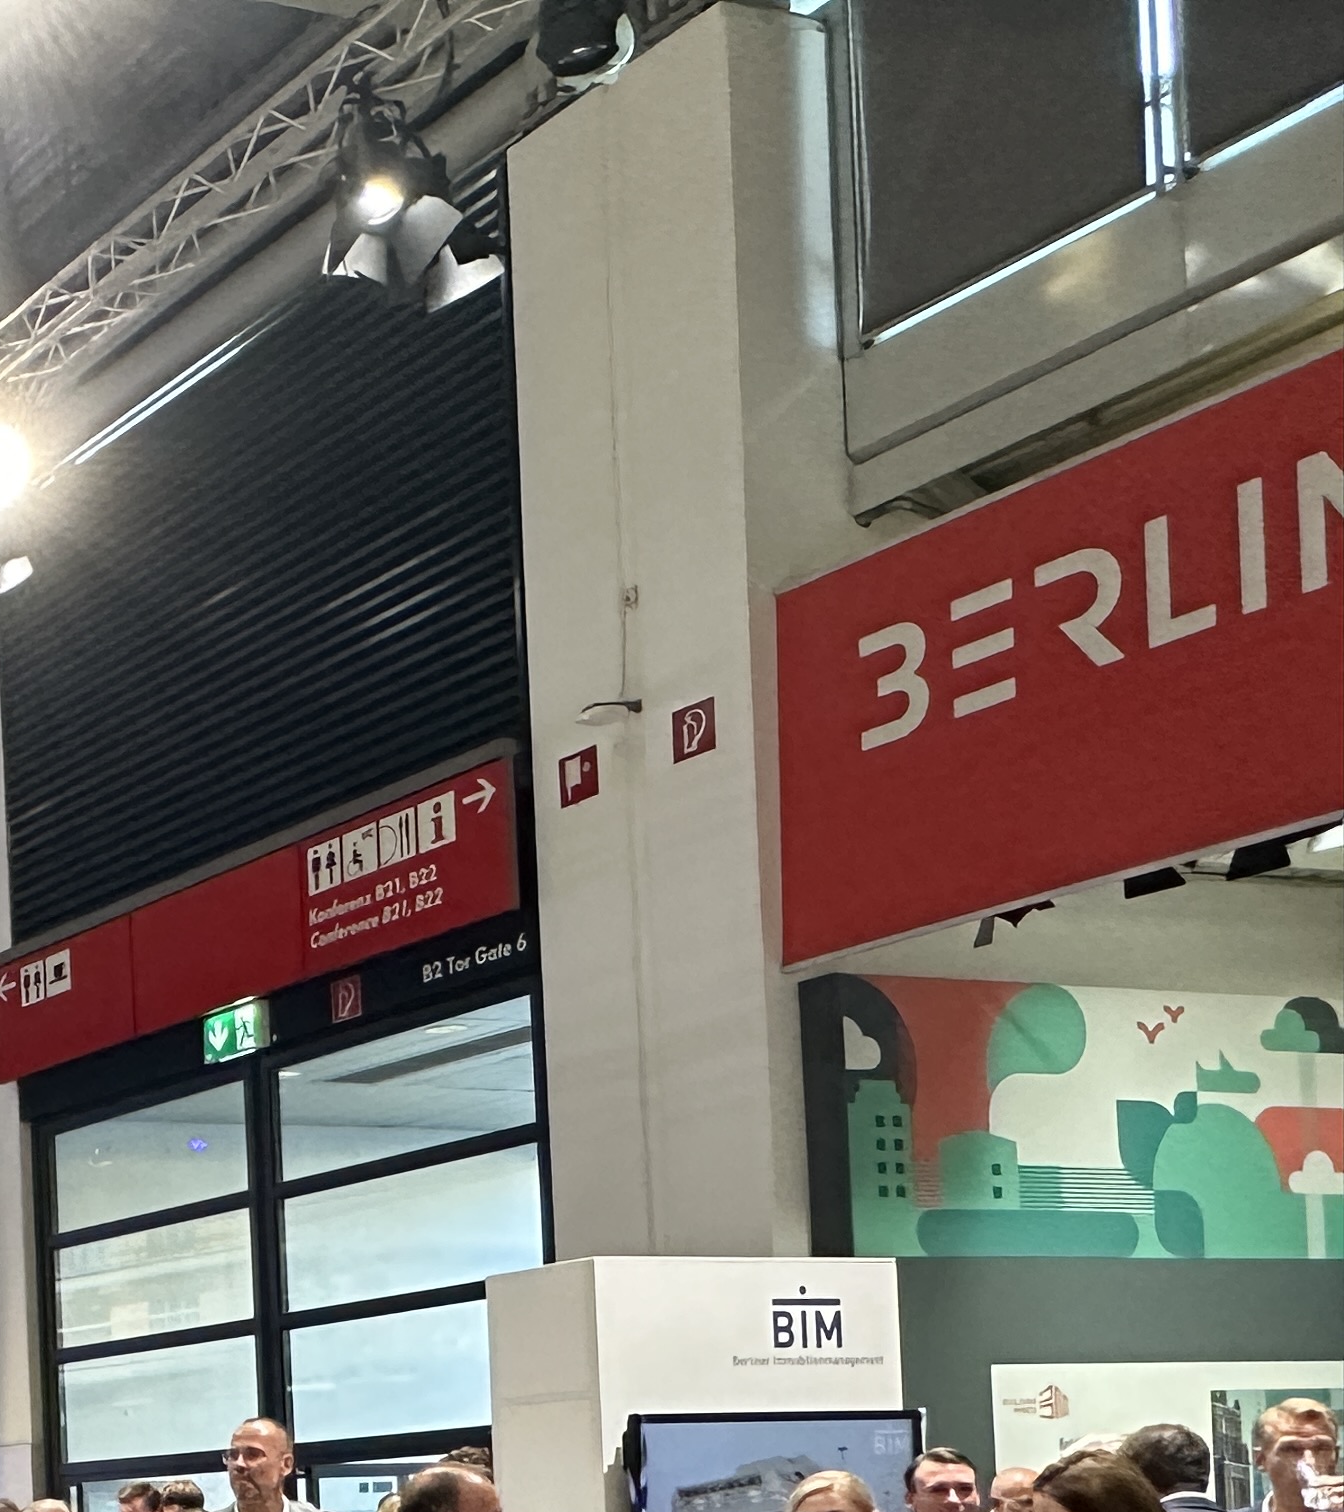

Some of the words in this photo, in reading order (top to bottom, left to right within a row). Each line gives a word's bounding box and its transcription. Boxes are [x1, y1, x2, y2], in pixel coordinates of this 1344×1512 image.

[409, 864, 438, 889] B22
[415, 887, 443, 912] B22
[423, 961, 443, 983] B2
[447, 956, 470, 975] Tor
[475, 941, 512, 965] Gate
[516, 932, 527, 952] 6
[773, 1310, 842, 1348] BIM
